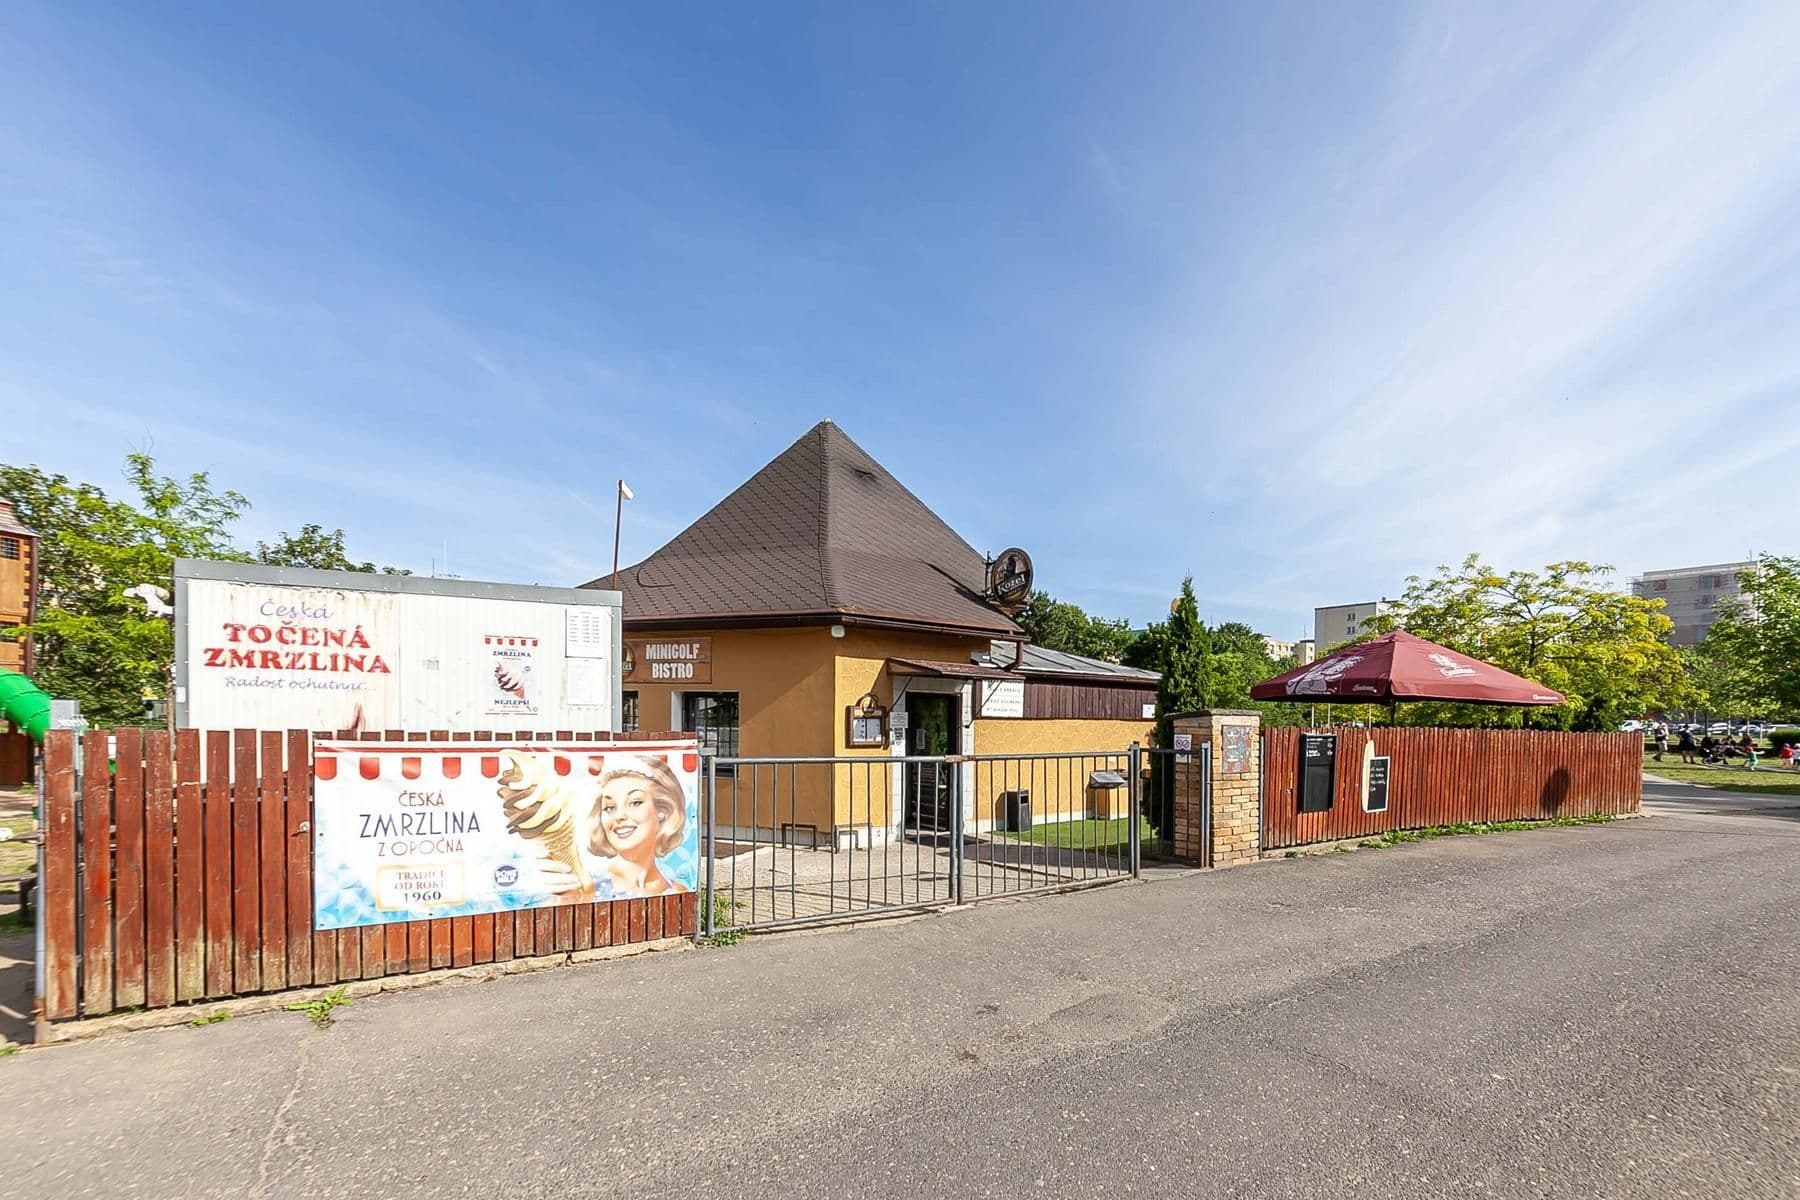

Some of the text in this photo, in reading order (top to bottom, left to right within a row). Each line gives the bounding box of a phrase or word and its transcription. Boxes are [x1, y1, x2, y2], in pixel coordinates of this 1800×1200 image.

[997, 574, 1026, 596] Kozel
[223, 620, 371, 649] TOČENÁ
[492, 650, 532, 658] ZMRZLINA
[645, 643, 700, 660] MINIGOLF
[203, 648, 392, 674] ZMRZLINA
[652, 662, 693, 679] BISTRO
[225, 675, 286, 688] Radost
[398, 789, 445, 807] ČESKÁ
[359, 810, 481, 838] ZMRZLINA
[377, 837, 464, 857] Z OPOČNA
[394, 881, 413, 891] OD
[403, 890, 442, 903] 1960
